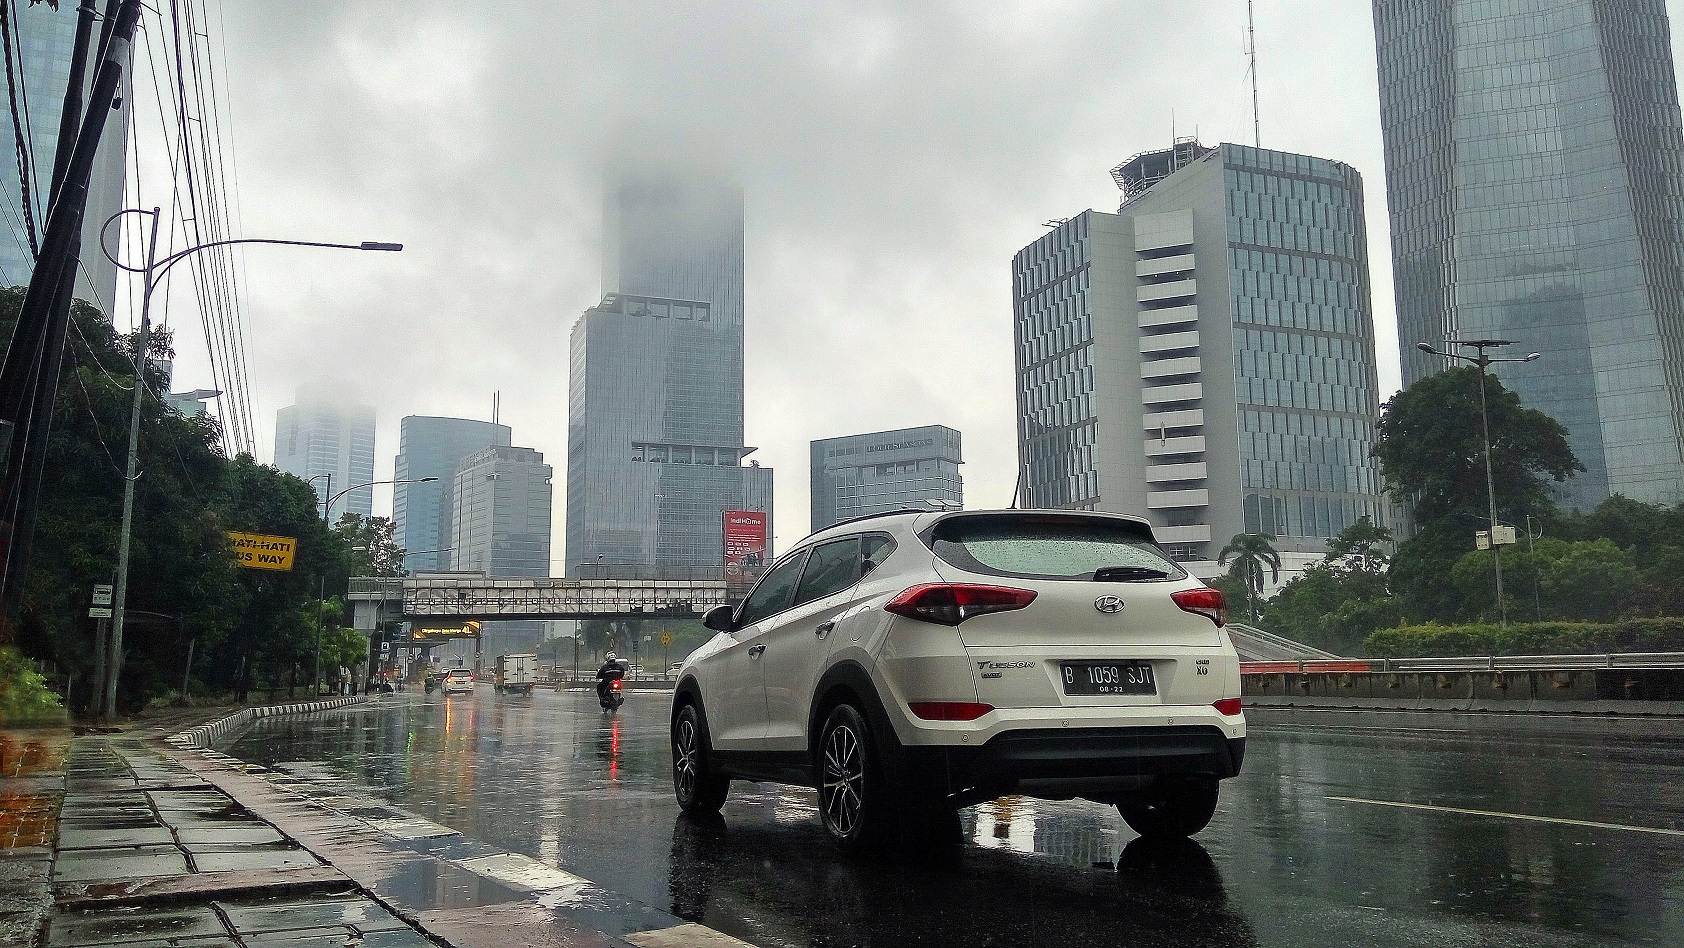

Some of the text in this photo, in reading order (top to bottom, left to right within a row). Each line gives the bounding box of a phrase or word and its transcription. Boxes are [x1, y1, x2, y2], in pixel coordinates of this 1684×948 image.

[236, 551, 286, 564] US WAY
[1065, 666, 1151, 684] B 1059 SJT
